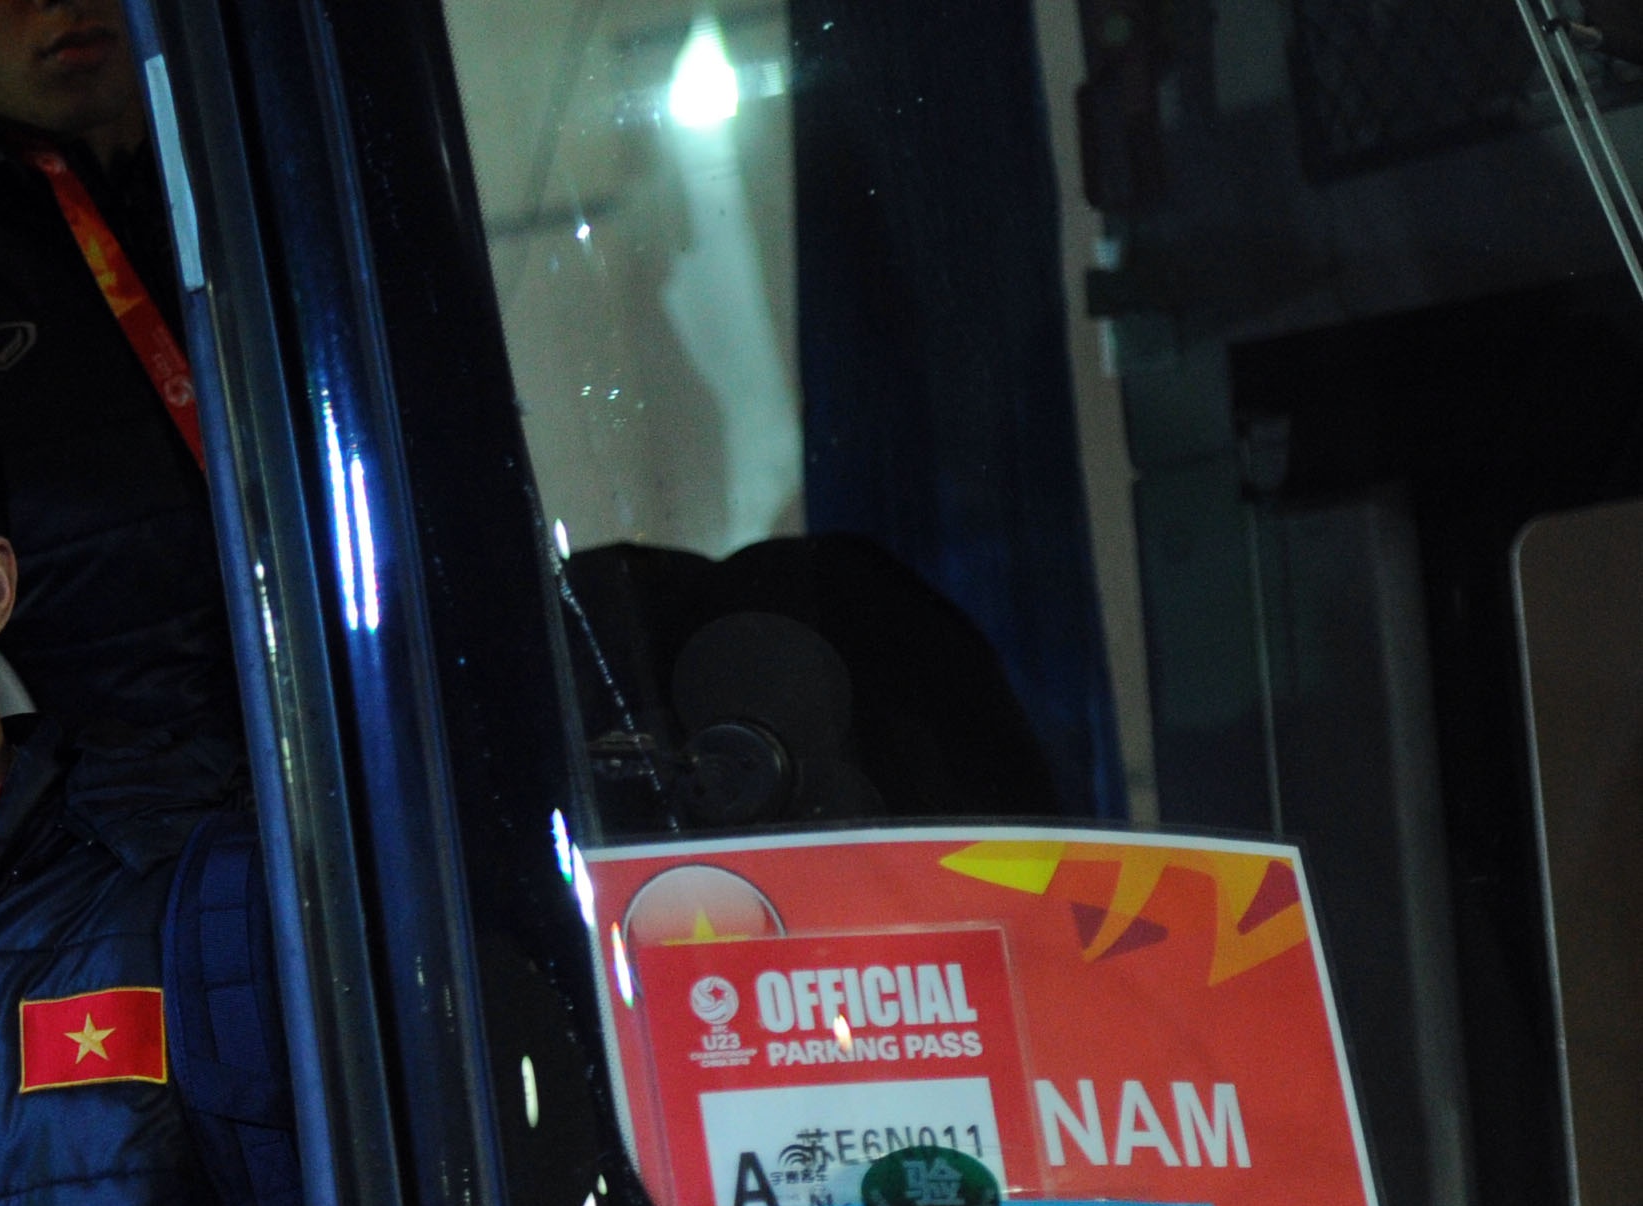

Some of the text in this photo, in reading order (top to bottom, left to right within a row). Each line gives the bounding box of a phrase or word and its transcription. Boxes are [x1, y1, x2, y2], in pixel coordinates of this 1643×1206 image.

[755, 962, 978, 1033] OFFICIAL
[701, 1033, 741, 1051] U23
[766, 1030, 983, 1067] PARKING PASS
[1033, 1078, 1253, 1169] NAM
